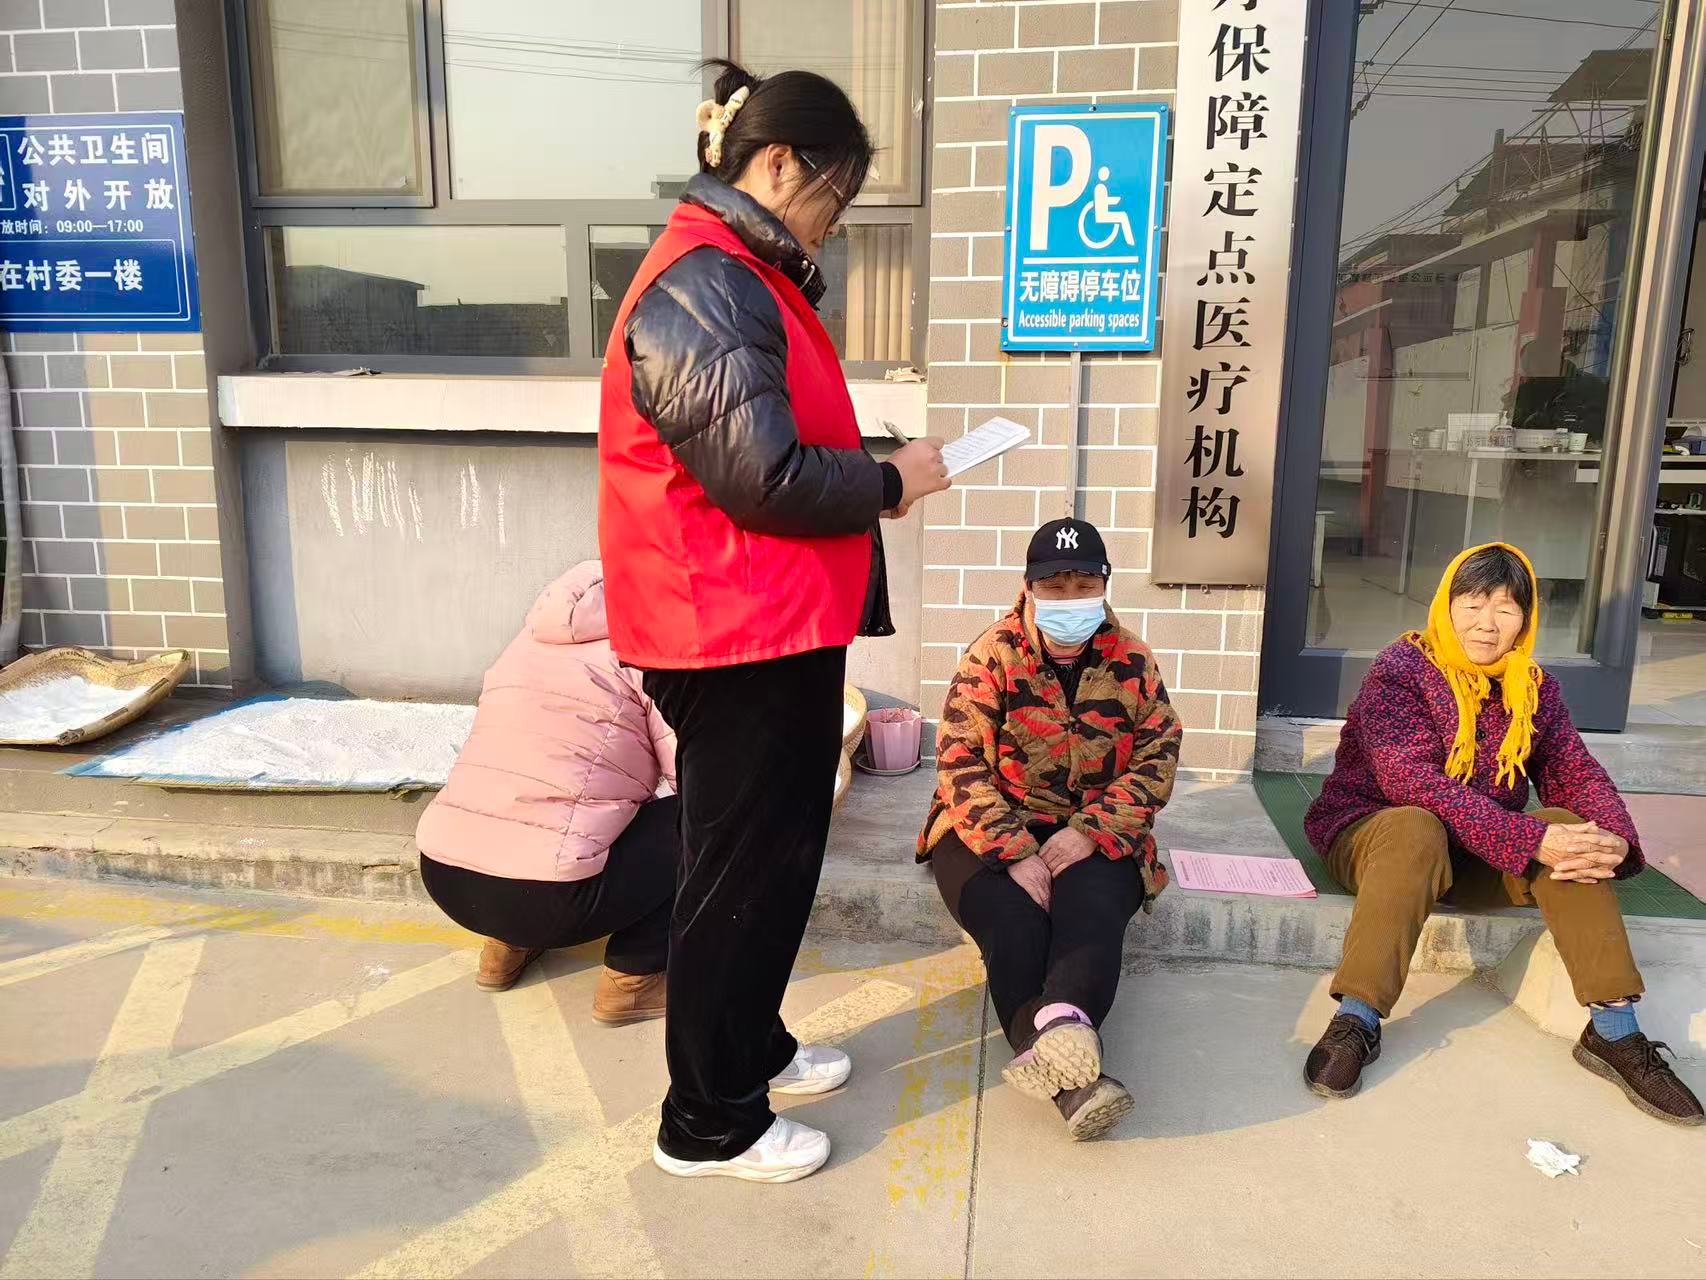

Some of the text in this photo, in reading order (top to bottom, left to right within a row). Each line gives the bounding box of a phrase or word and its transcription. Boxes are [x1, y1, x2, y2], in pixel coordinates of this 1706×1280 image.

[18, 133, 170, 166] 公共卫生间
[1030, 124, 1092, 250] P
[0, 259, 143, 291] 在村委一楼
[1019, 269, 1142, 303] 无障碍停车位
[1019, 309, 1140, 332] Accessible parking spaces
